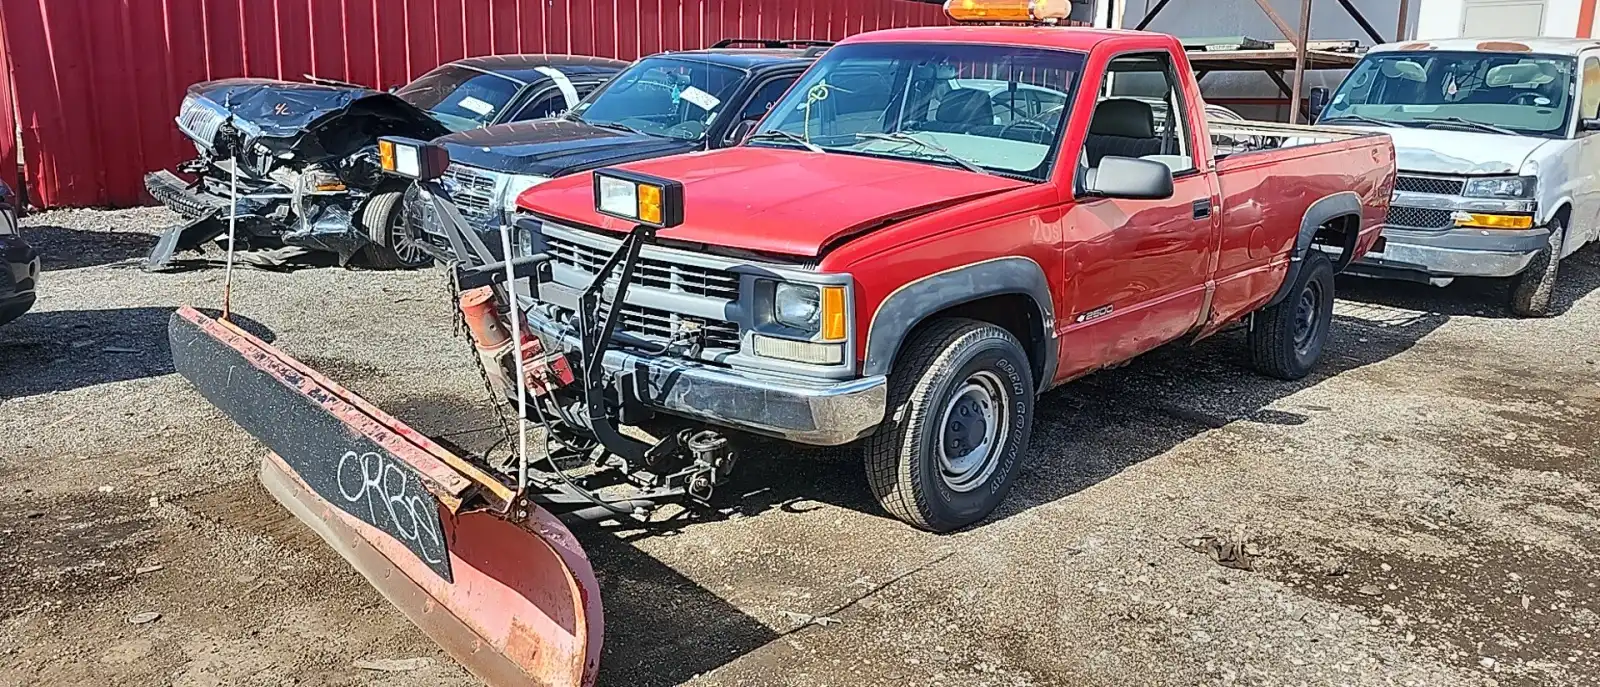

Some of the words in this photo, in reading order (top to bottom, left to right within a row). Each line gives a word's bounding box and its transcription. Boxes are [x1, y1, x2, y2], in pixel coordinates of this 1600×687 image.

[1085, 304, 1114, 321] 2500
[995, 358, 1024, 396] OPEN
[990, 401, 1026, 495] COUNTRY
